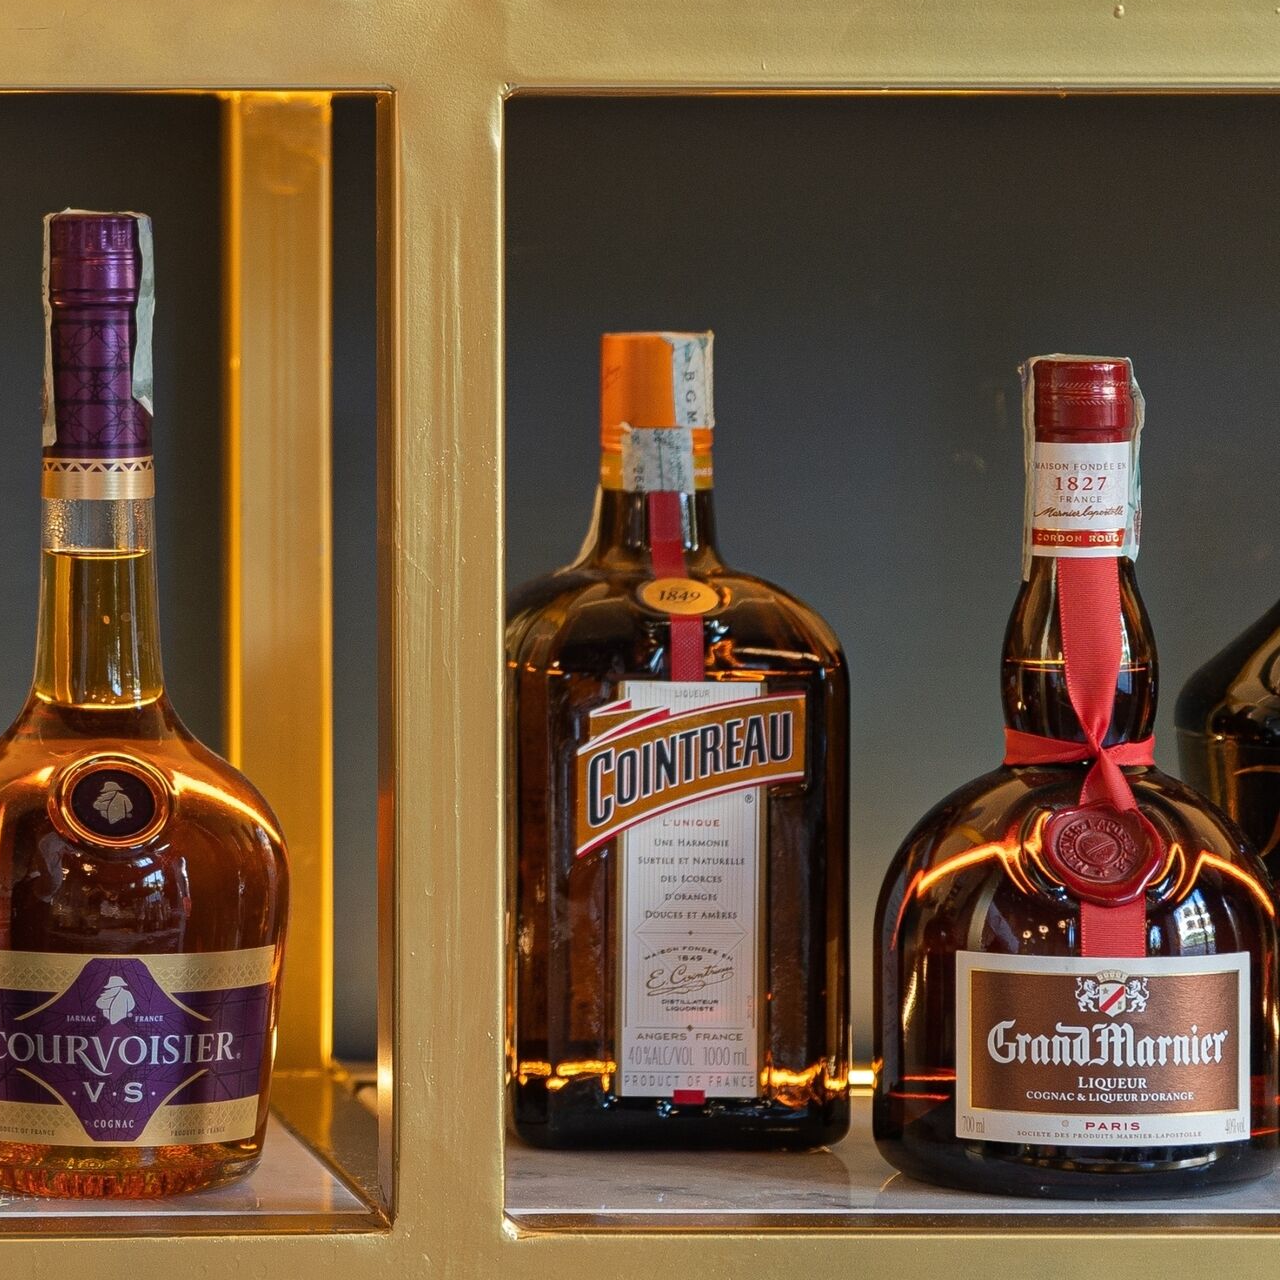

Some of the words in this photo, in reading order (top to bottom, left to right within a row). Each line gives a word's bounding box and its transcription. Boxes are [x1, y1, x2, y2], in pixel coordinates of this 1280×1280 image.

[1035, 462, 1069, 471] MAISON
[1073, 461, 1115, 471] FONDÉE
[1055, 476, 1108, 491] 1827
[1059, 495, 1102, 503] FRANCE
[1036, 533, 1082, 543] CORDON
[658, 589, 701, 603] 1849
[674, 690, 711, 699] LIQUEUR
[587, 710, 794, 828] COINTREAU
[662, 819, 720, 828] L'UNIQUE
[66, 1015, 97, 1024] JARNAC
[134, 1015, 164, 1023] FRANCE
[635, 1032, 688, 1041] ANGERS
[695, 1033, 743, 1041] FRANCE
[987, 1019, 1092, 1065] Grand
[1088, 1022, 1228, 1067] Marnier
[703, 1046, 730, 1066] 1000
[624, 1075, 680, 1088] PRODUCT
[687, 1075, 701, 1087] OF
[708, 1075, 756, 1088] FRANCE
[1078, 1076, 1148, 1091] LIQUEUR
[1026, 1090, 1075, 1102] COGNAC
[1077, 1091, 1086, 1102] &
[1088, 1091, 1139, 1104] LIQUEUR
[1140, 1090, 1195, 1102] D'ORANGE
[93, 1119, 136, 1130] COGNAC
[1085, 1121, 1141, 1132] PARIS
